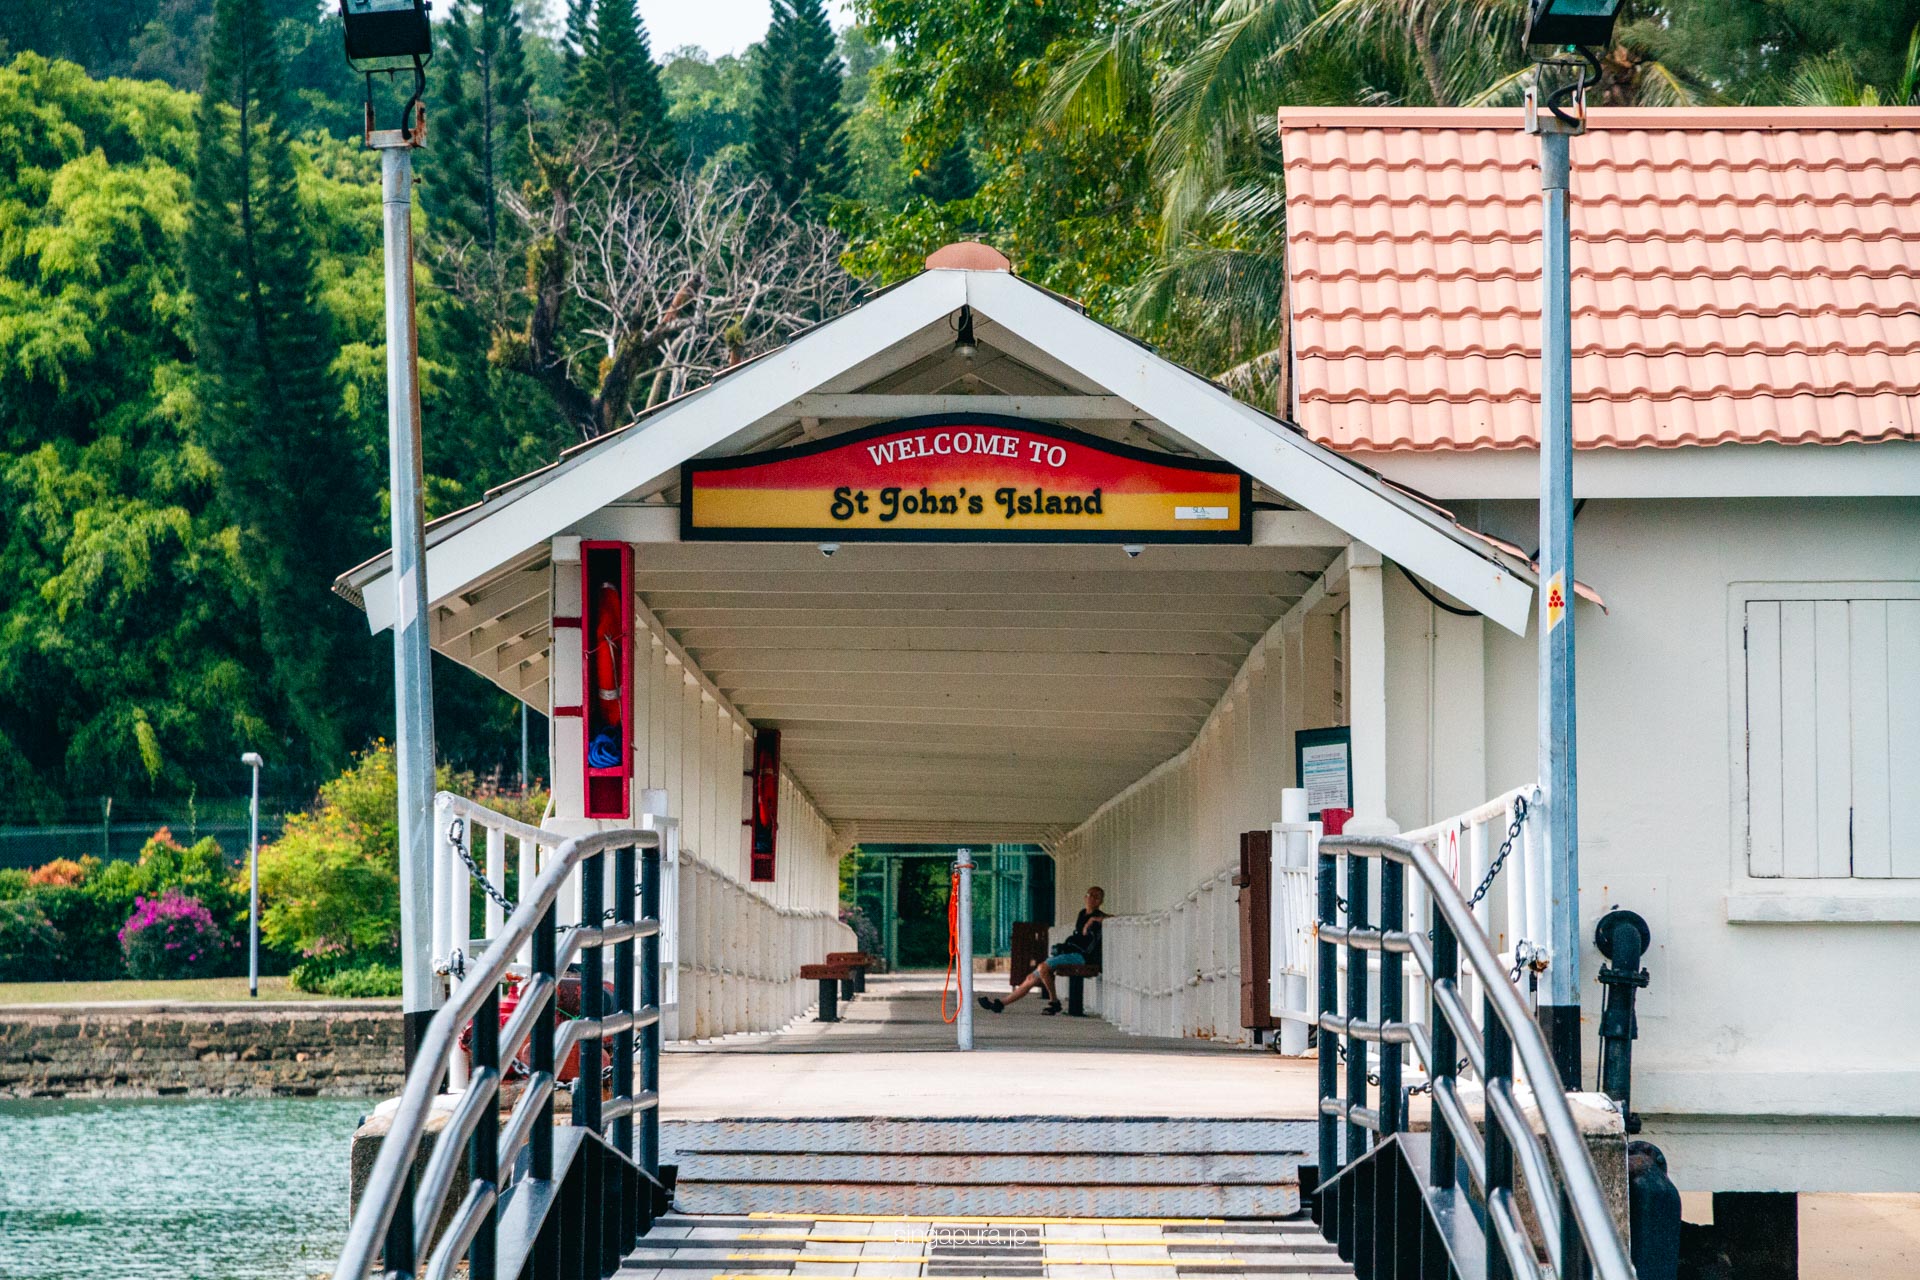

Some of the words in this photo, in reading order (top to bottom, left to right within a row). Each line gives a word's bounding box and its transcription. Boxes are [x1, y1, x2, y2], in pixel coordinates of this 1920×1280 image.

[867, 432, 1019, 466] WELCOME
[1028, 441, 1067, 467] TO
[830, 486, 869, 520] St
[879, 487, 983, 522] John's
[995, 487, 1103, 519] Island
